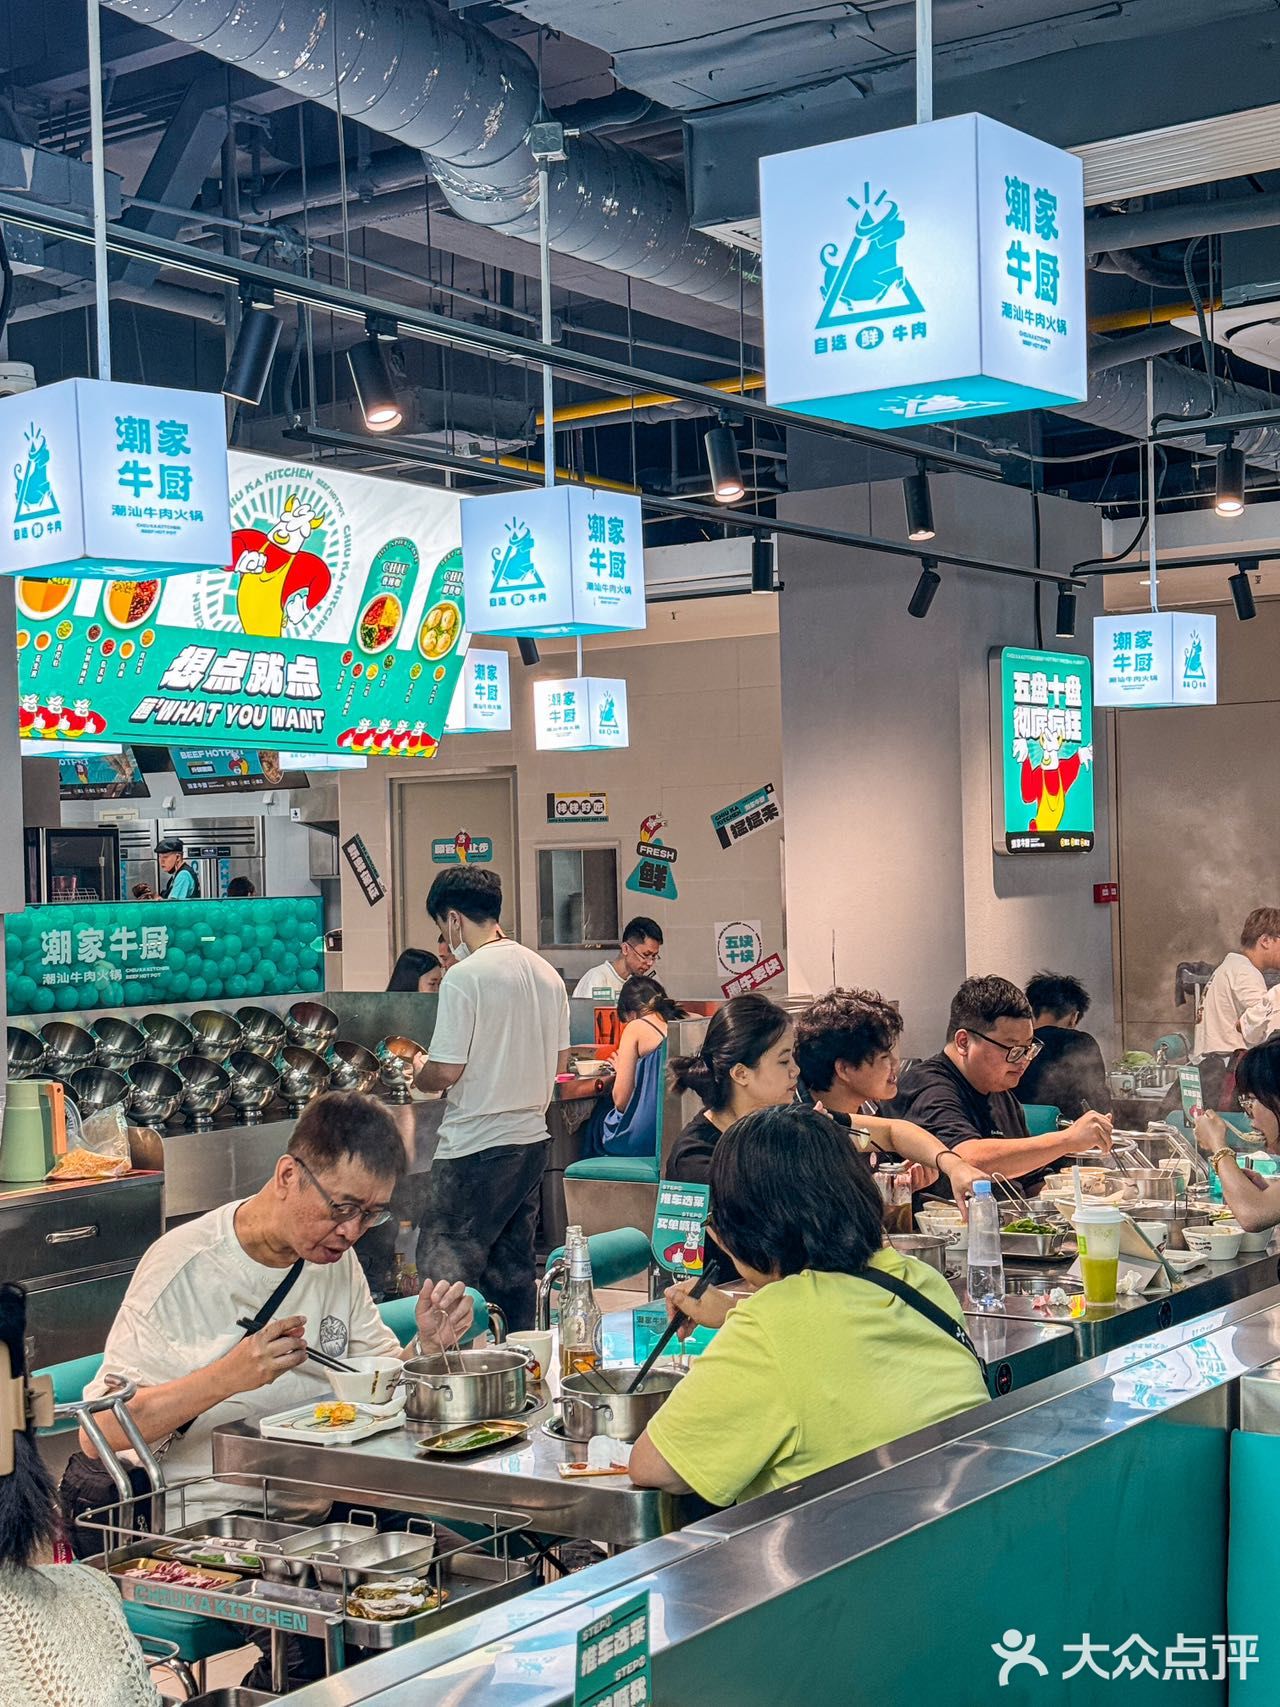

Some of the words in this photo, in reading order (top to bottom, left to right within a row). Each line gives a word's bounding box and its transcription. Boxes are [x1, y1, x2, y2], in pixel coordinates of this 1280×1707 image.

[1005, 175, 1059, 241] 潮家
[1005, 240, 1060, 306] 牛厨
[1001, 301, 1067, 336] 潮汕牛肉火锅
[814, 334, 848, 355] 自选
[892, 321, 927, 342] 牛肉
[115, 415, 192, 454] 潮家
[117, 460, 193, 502] 牛厨
[244, 477, 263, 494] KA
[264, 467, 314, 483] KITCHEN
[112, 504, 204, 522] 潮汕牛肉火锅
[587, 513, 625, 545] 潮家
[343, 524, 351, 557] CHIU
[382, 561, 410, 576] CHIU
[589, 547, 626, 580] 牛厨
[308, 586, 343, 640] KITCHEN
[1113, 630, 1153, 650] 潮家
[158, 645, 322, 700] 想点就点
[474, 664, 498, 681] 潮家
[1113, 653, 1153, 673] 牛厨
[474, 683, 498, 701] 牛厨
[548, 691, 575, 706] 潮家
[1013, 671, 1082, 708] 五盘十盘
[224, 703, 268, 729] YOU
[270, 706, 325, 733] WANT
[549, 708, 576, 723] 牛厨
[1013, 706, 1082, 743] 彻底疯狂
[180, 751, 204, 759] BEEF
[730, 803, 779, 839] 猛猛来
[640, 845, 675, 860] FRESH
[639, 861, 667, 891] 鲜
[41, 926, 169, 965] 潮家牛厨
[725, 935, 753, 949] 五块
[726, 950, 754, 964] 十块
[42, 969, 122, 985] 潮汕牛肉火锅
[214, 1599, 308, 1632] KITCHEN
[581, 1615, 646, 1677] 推车选菜
